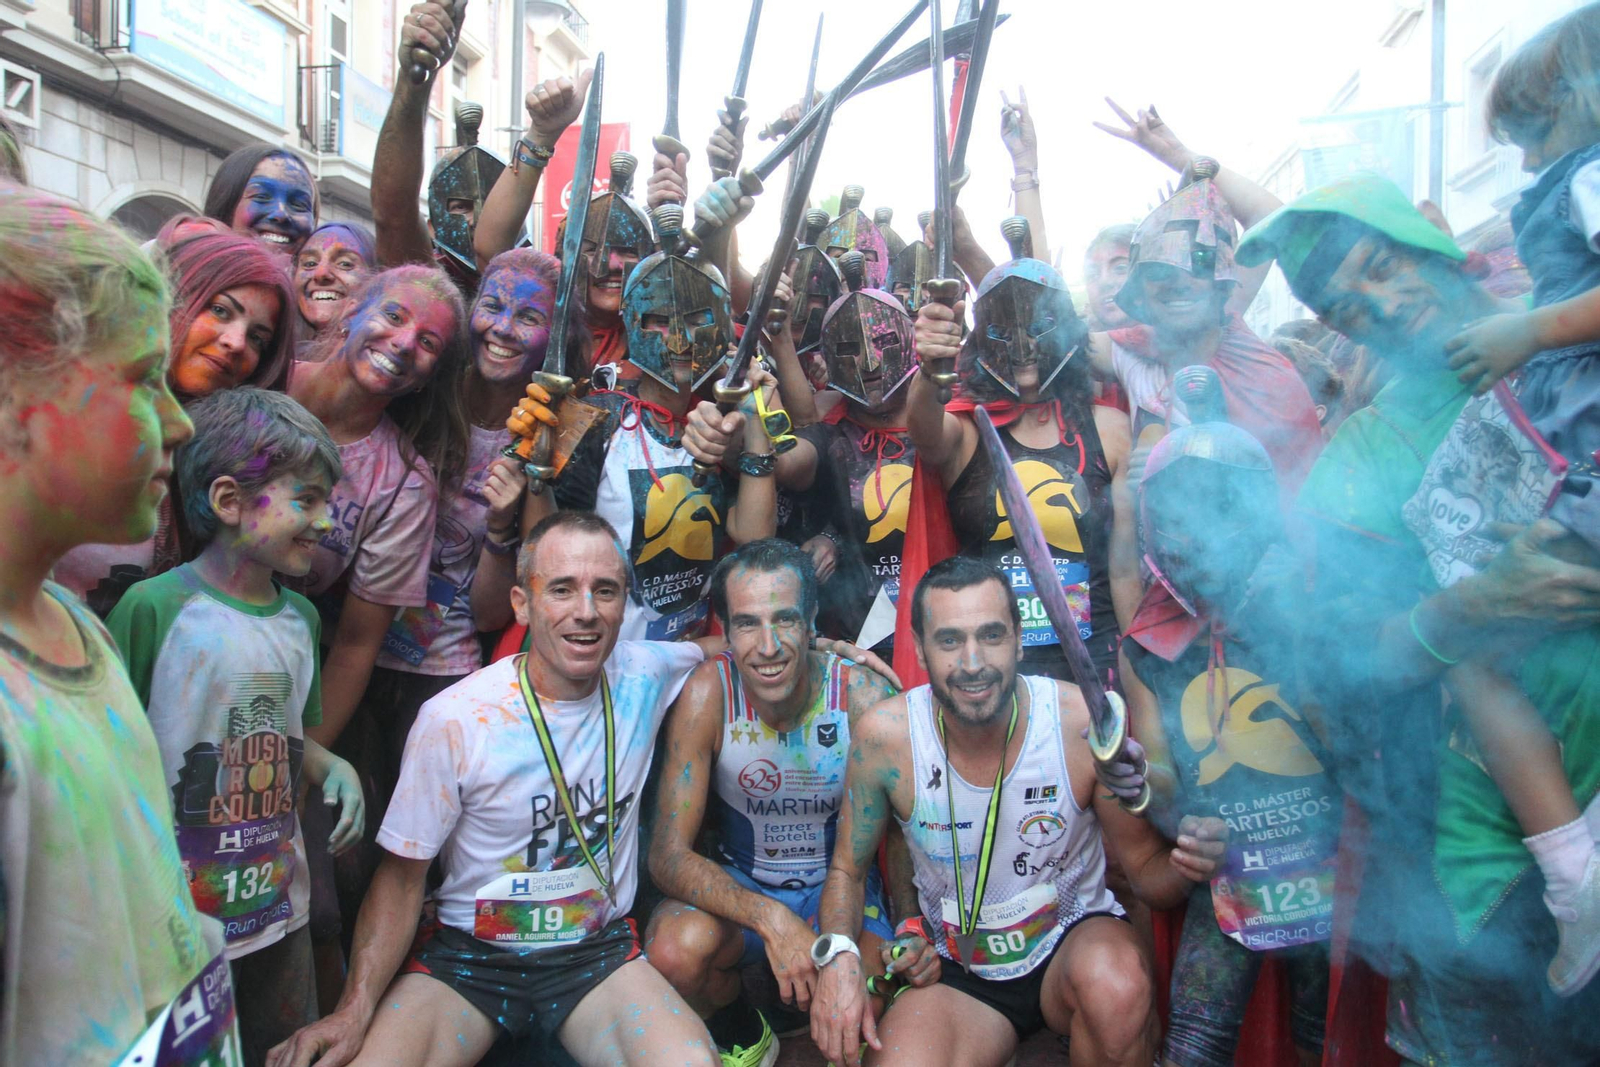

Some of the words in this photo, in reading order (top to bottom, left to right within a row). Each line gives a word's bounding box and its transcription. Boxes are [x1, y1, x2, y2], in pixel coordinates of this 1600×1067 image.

[1430, 498, 1470, 531] love
[879, 556, 889, 564] C.
[890, 555, 901, 563] D.
[1001, 556, 1011, 564] C.
[1013, 556, 1024, 565] D.
[872, 564, 902, 575] TAR
[643, 578, 651, 588] C.
[653, 576, 662, 585] D.
[643, 574, 704, 600] ARTESSOS
[652, 592, 682, 608] HUELVA
[746, 794, 836, 816] MARTÍN
[1219, 803, 1233, 816] C.
[1235, 802, 1251, 814] D.
[1253, 786, 1312, 810] MÁSTER
[1224, 795, 1332, 832] ARTESSOS
[763, 823, 813, 833] ferrer
[763, 831, 817, 843] hotels
[1247, 824, 1302, 843] HUELVA
[243, 838, 255, 848] DE
[255, 830, 279, 845] HUELVA
[781, 846, 817, 854] UCAM
[1267, 856, 1280, 866] DE
[1281, 847, 1316, 864] HUELVA
[223, 862, 274, 903] 132
[532, 884, 543, 893] DE
[544, 882, 575, 892] HUELVA
[533, 872, 579, 885] DIPUTACIÓN
[1257, 877, 1321, 913] 123
[983, 896, 1029, 916] DIPUTACIÓN
[997, 905, 1027, 920] HUELVA
[1244, 912, 1283, 927] VICTORIA
[1318, 902, 1333, 914] DÍA
[222, 918, 256, 937] Run
[528, 906, 564, 932] 19
[496, 933, 522, 941] DANIEL
[524, 931, 556, 940] AGUIRRE
[557, 927, 587, 939] MORENO
[986, 930, 1026, 956] 60
[1243, 927, 1309, 947] usicRun
